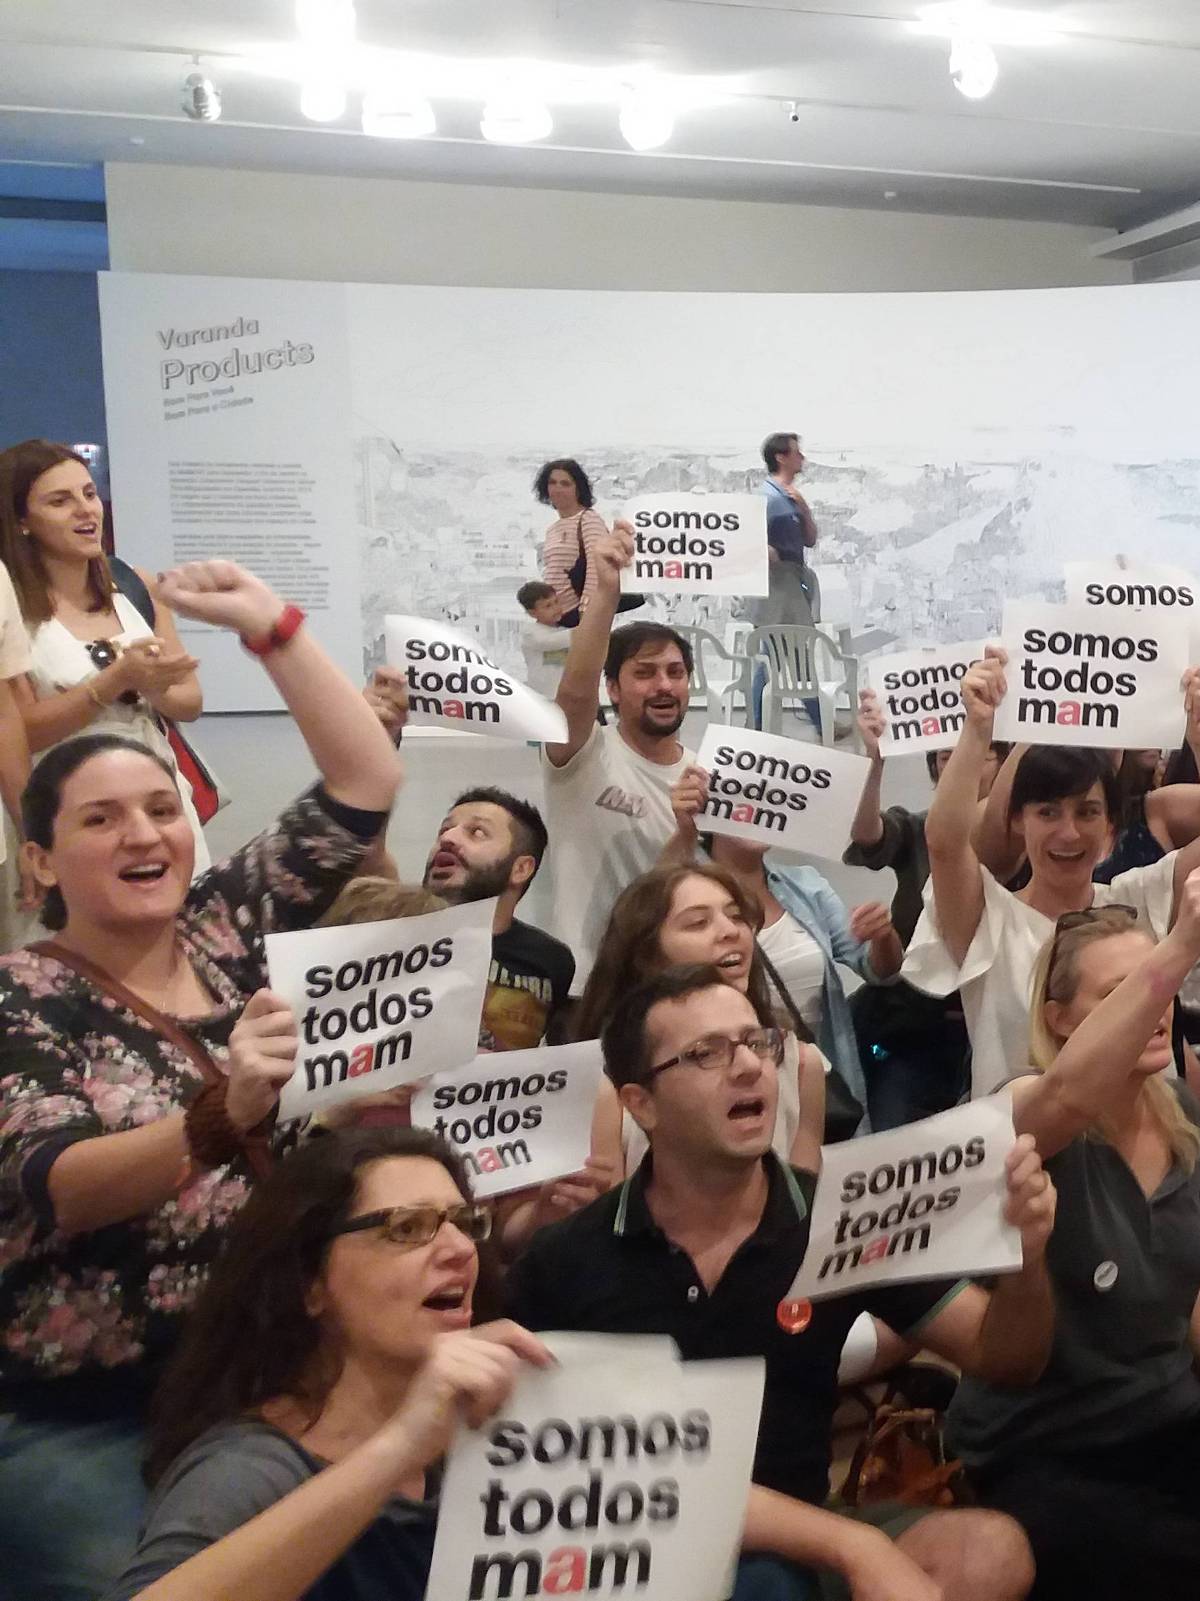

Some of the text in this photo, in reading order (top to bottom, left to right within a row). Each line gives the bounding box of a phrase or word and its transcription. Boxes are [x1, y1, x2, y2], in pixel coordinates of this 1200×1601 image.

[158, 316, 259, 350] Varanda
[161, 339, 315, 389] Products
[635, 511, 740, 531] somos
[634, 533, 725, 557] todos
[635, 559, 713, 581] mam
[1086, 583, 1194, 606] somos
[1024, 628, 1158, 661] somos
[404, 666, 513, 697] todos
[884, 659, 978, 690] somo
[1020, 659, 1136, 696] todos
[408, 696, 501, 723] mam
[887, 688, 965, 716] todo
[1018, 698, 1119, 728] mam
[891, 711, 966, 740] mam
[714, 745, 832, 790] somos
[709, 768, 807, 811] todos
[702, 796, 787, 832] mam
[304, 937, 452, 998] somos
[301, 986, 433, 1045] todos
[304, 1030, 412, 1090] mam
[433, 1069, 567, 1109] somos
[434, 1104, 543, 1145] todos
[839, 1137, 985, 1203] somos
[834, 1185, 961, 1244] todos
[818, 1224, 931, 1280] mam
[486, 1408, 711, 1467] somos
[480, 1470, 679, 1538] todos
[469, 1541, 652, 1601] mam
